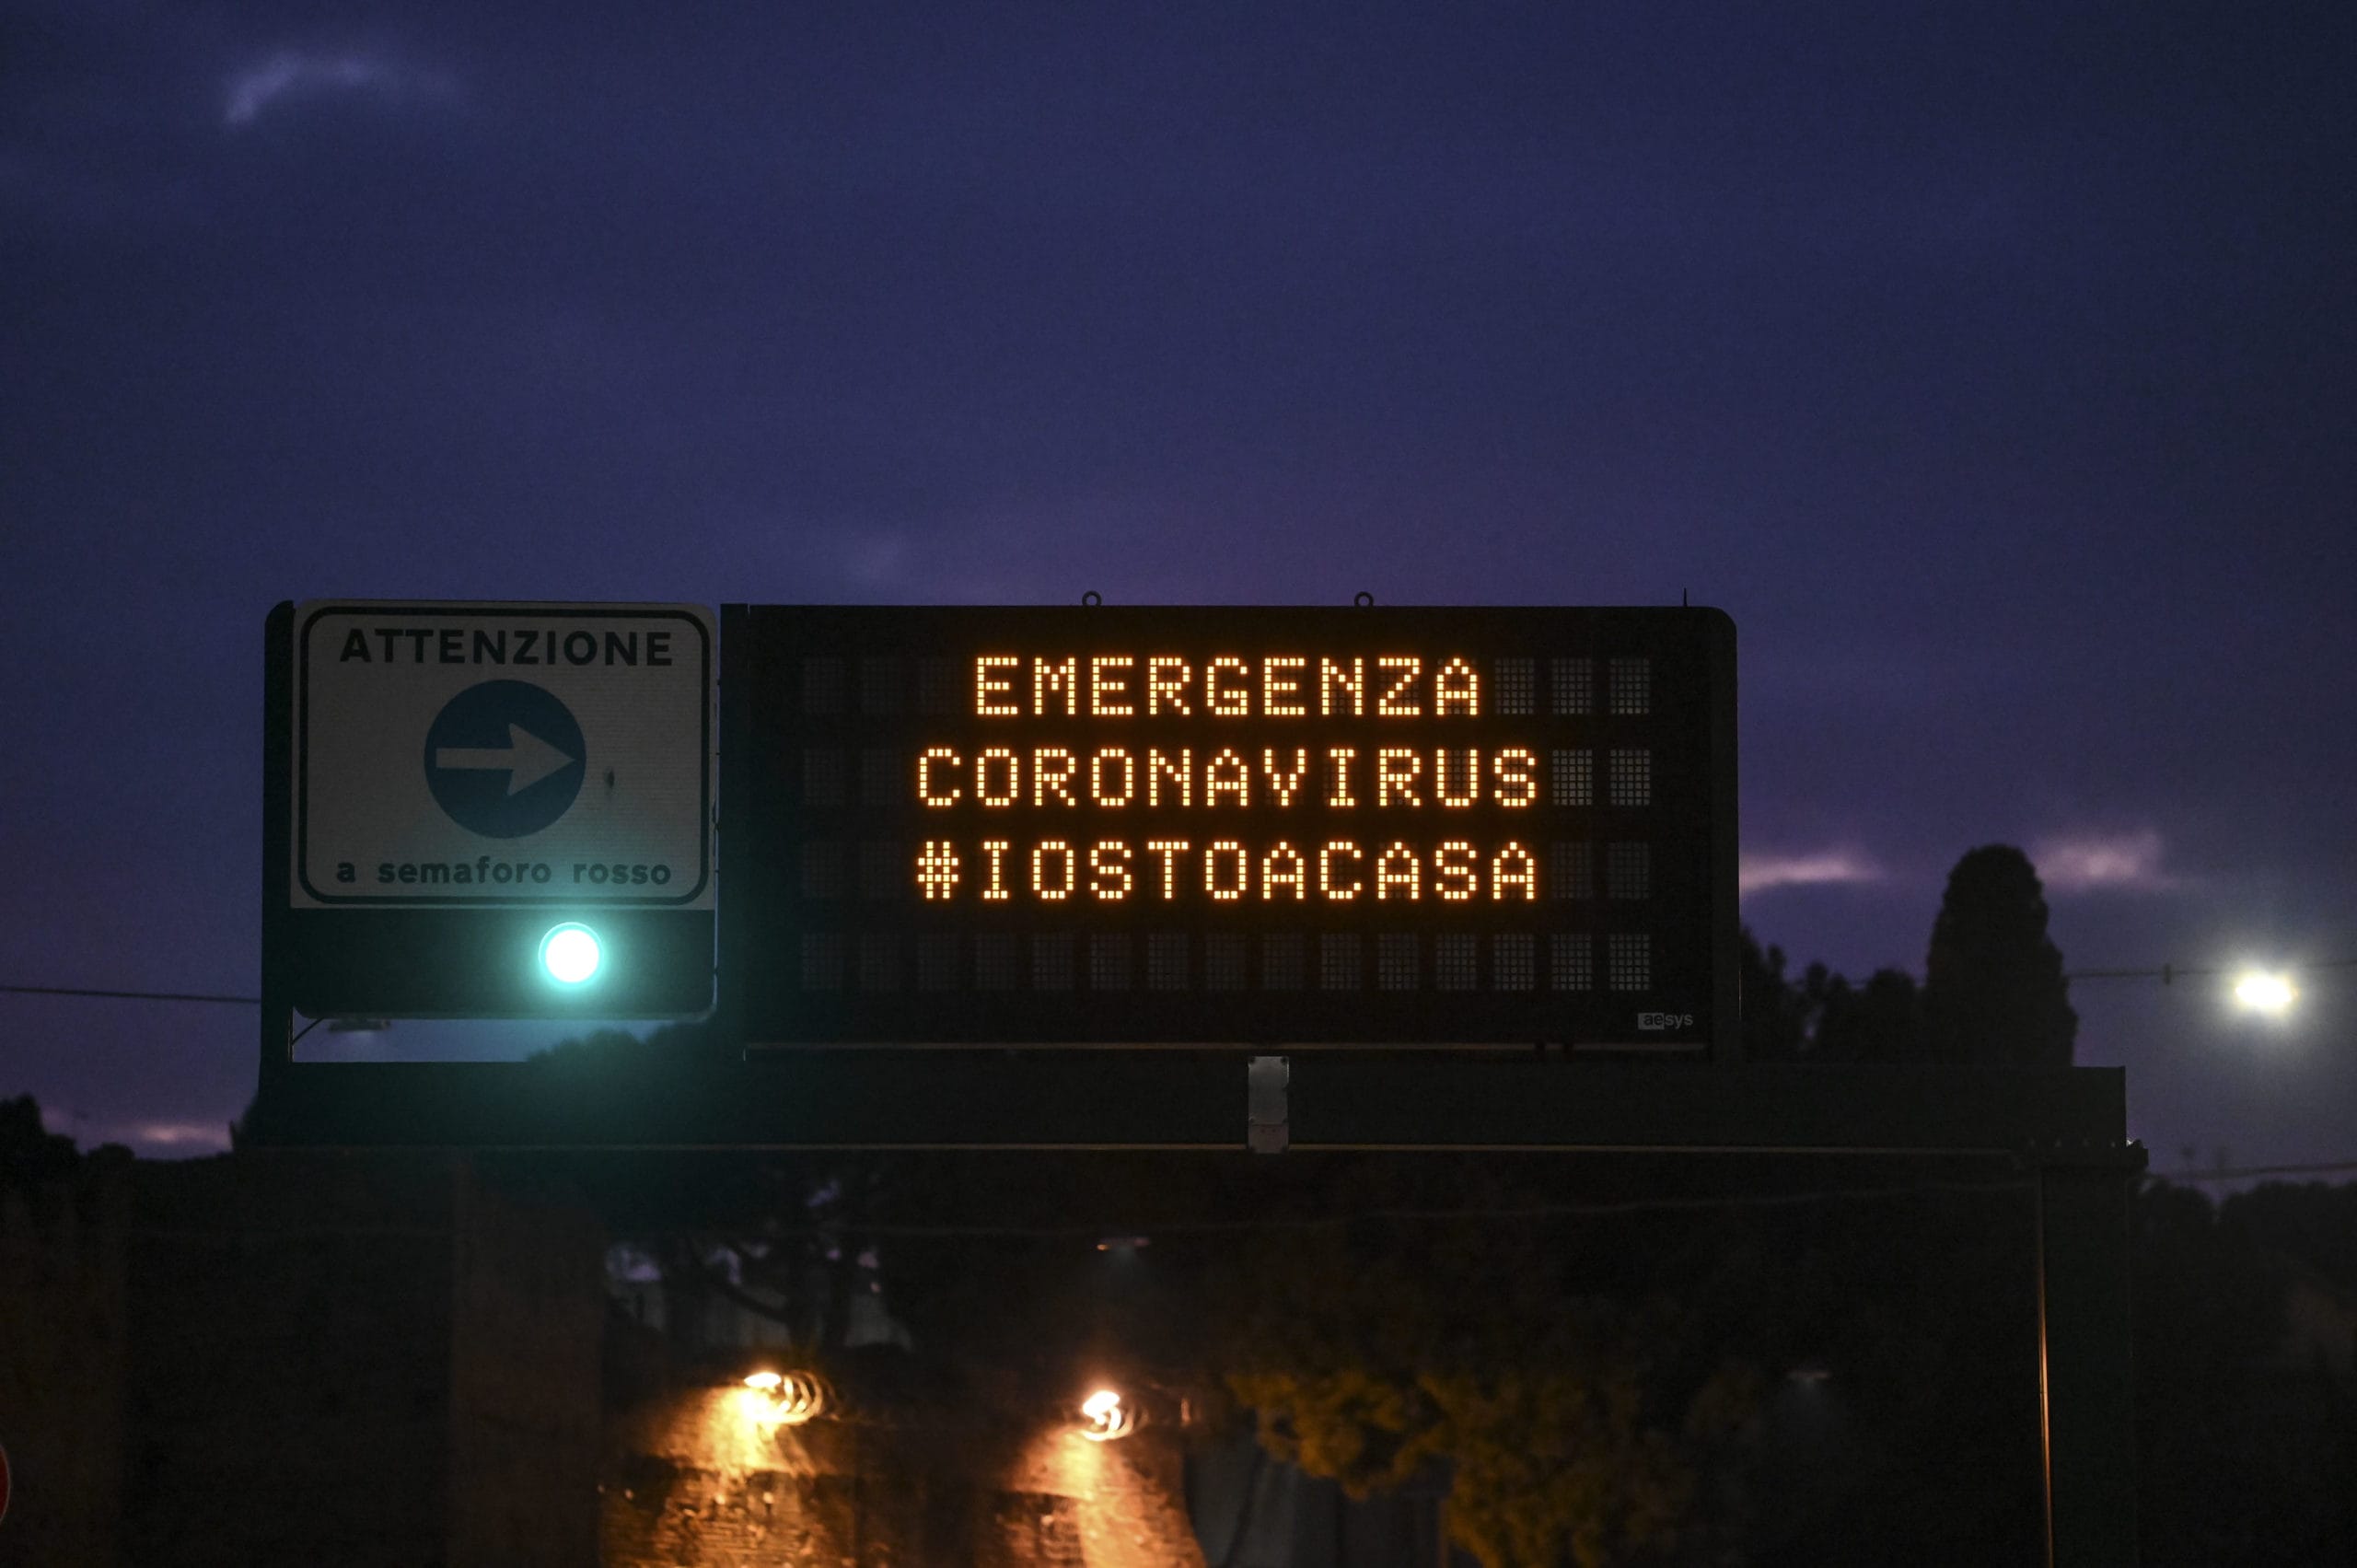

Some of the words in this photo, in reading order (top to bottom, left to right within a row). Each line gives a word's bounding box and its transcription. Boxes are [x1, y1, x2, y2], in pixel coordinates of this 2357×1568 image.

[339, 628, 673, 667] ATTENZIONE
[975, 655, 1480, 717] EMERGENZA
[917, 747, 1537, 808] CORONAVIRUS
[336, 863, 356, 883] a
[377, 856, 552, 884] semaforo
[573, 863, 672, 885] rosso
[916, 840, 1536, 901] #IOSTOACASA
[1642, 1014, 1694, 1029] aesys
